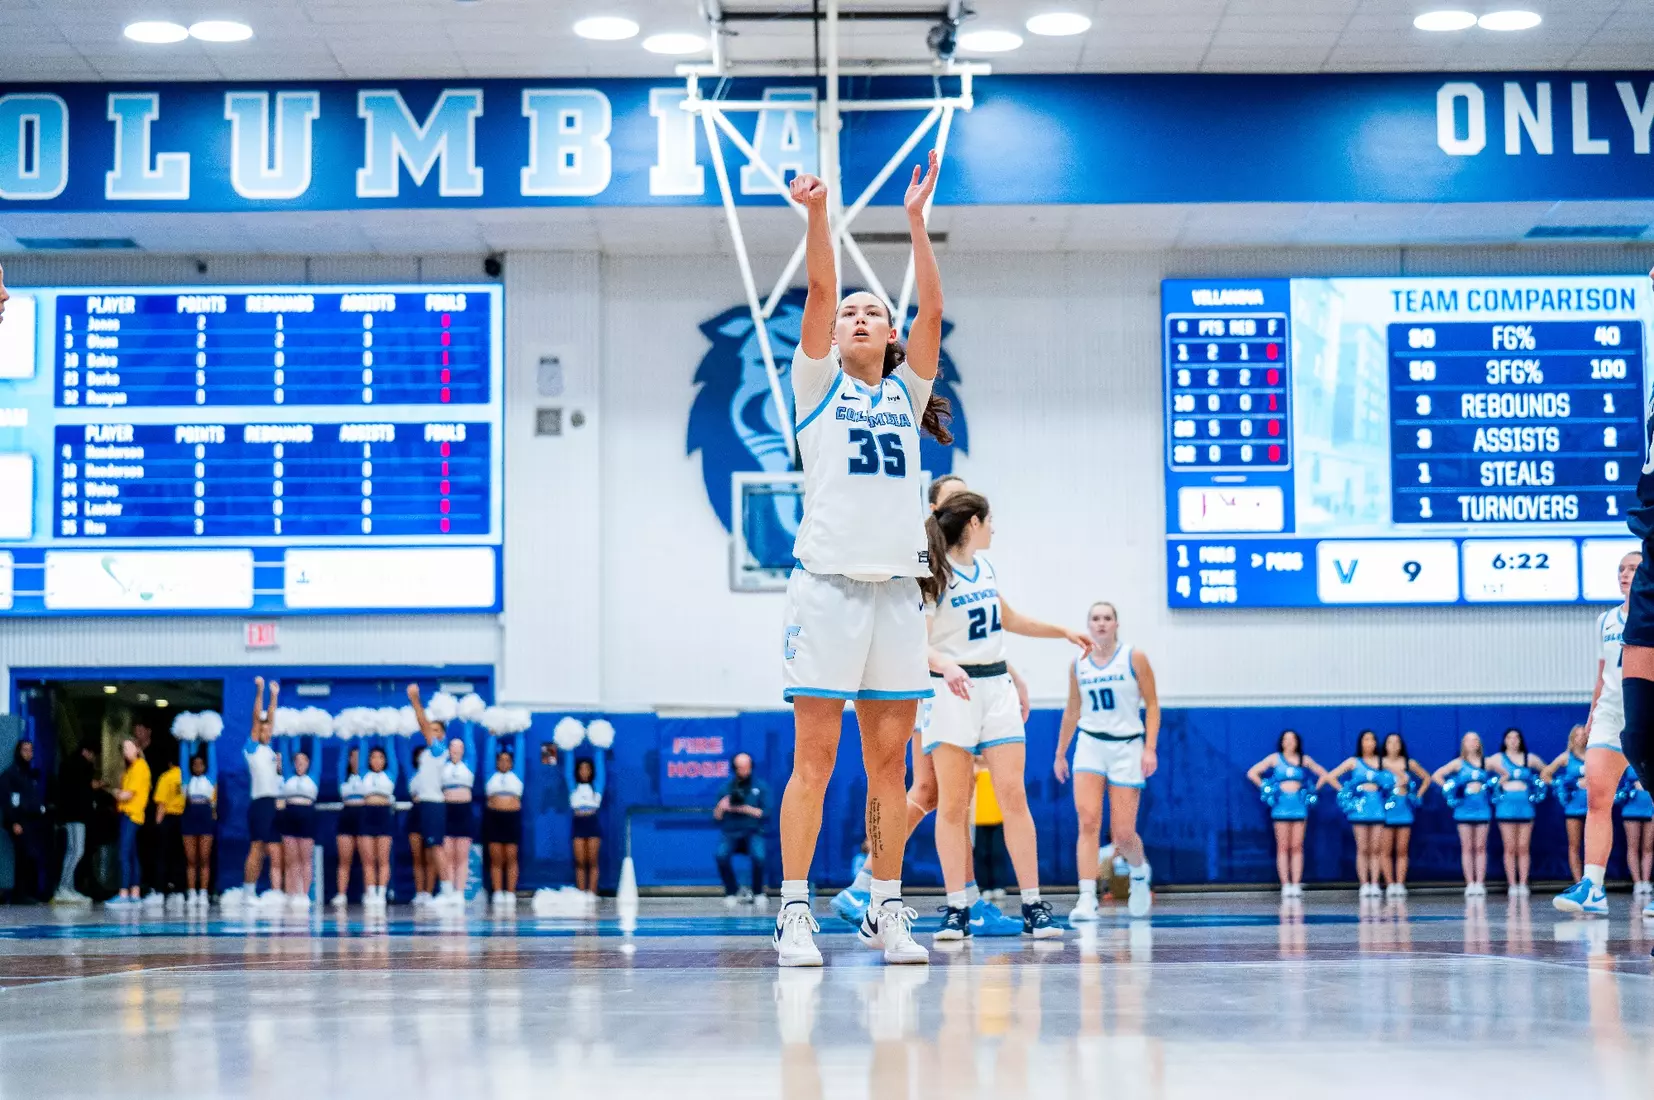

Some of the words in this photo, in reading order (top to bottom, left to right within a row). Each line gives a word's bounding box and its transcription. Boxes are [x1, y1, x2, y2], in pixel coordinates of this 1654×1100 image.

[1436, 81, 1654, 156] ONLY
[88, 296, 135, 313] PLAYER
[1391, 289, 1457, 313] TEAM
[1467, 287, 1636, 312] COMPARISON
[1493, 326, 1535, 349] FG%
[1595, 327, 1620, 345] 40
[196, 351, 207, 368] 0
[1208, 344, 1218, 360] 2
[1241, 344, 1248, 360] 1
[1208, 370, 1218, 385] 2
[1240, 369, 1250, 385] 2
[1486, 360, 1543, 384] 3FG%
[1591, 359, 1626, 378] 100
[195, 388, 206, 405] 0
[1208, 395, 1219, 411] 0
[1240, 394, 1251, 410] 0
[1462, 393, 1570, 418] REBOUNDS
[1604, 394, 1614, 412] 1
[85, 424, 133, 442] PLAYER
[1474, 427, 1559, 452] ASSISTS
[194, 442, 206, 460] 0
[848, 428, 907, 478] 35
[1209, 445, 1220, 462] 0
[1241, 445, 1252, 461] 0
[195, 462, 205, 479] 0
[1419, 463, 1431, 483] 1
[1481, 461, 1554, 486] STEALS
[1605, 462, 1618, 480] 0
[194, 481, 205, 498] 0
[194, 499, 205, 517] 0
[1420, 497, 1432, 517] 1
[1458, 495, 1578, 520] TURNOVERS
[1607, 496, 1617, 515] 1
[1177, 545, 1189, 567] 1
[1492, 553, 1549, 570] 6:22
[1332, 559, 1358, 584] V
[1403, 561, 1422, 582] 9
[248, 623, 275, 646] EXIT
[1088, 688, 1116, 711] 10
